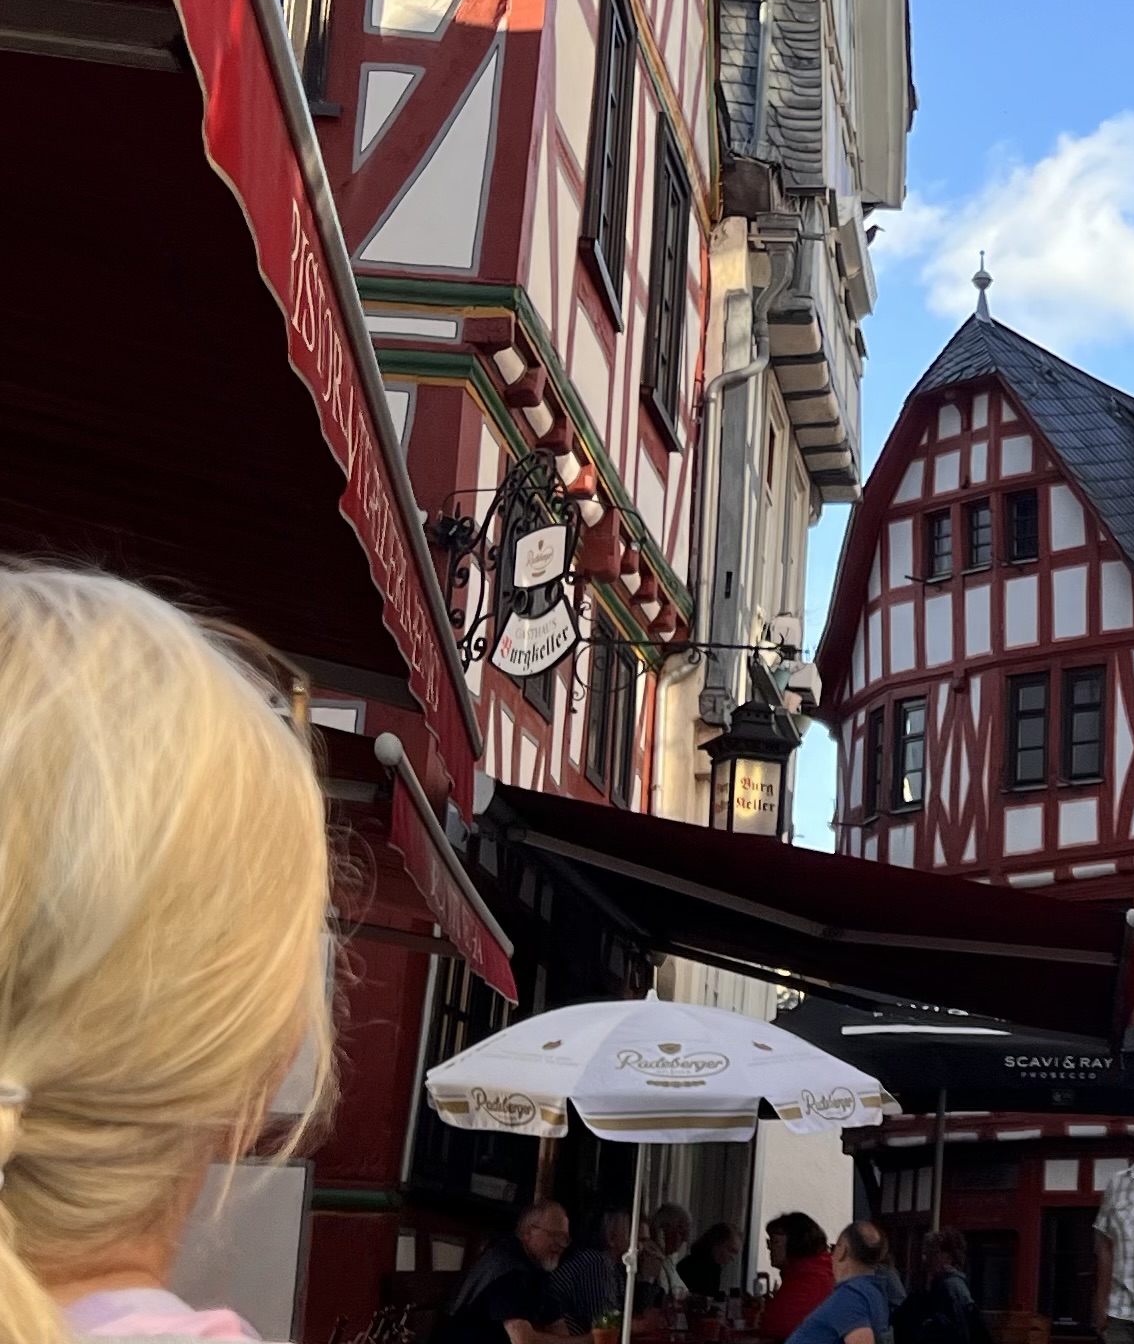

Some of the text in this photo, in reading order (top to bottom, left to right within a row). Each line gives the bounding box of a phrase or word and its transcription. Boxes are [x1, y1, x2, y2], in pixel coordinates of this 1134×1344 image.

[515, 617, 557, 641] GASTHAUS
[500, 626, 569, 671] Burgkeller
[741, 776, 774, 796] Burg
[736, 797, 776, 812] Keller
[615, 1049, 727, 1074] Radeberger
[1004, 1056, 1114, 1069] SCAVI & RAY
[1020, 1071, 1097, 1079] PROSECCO
